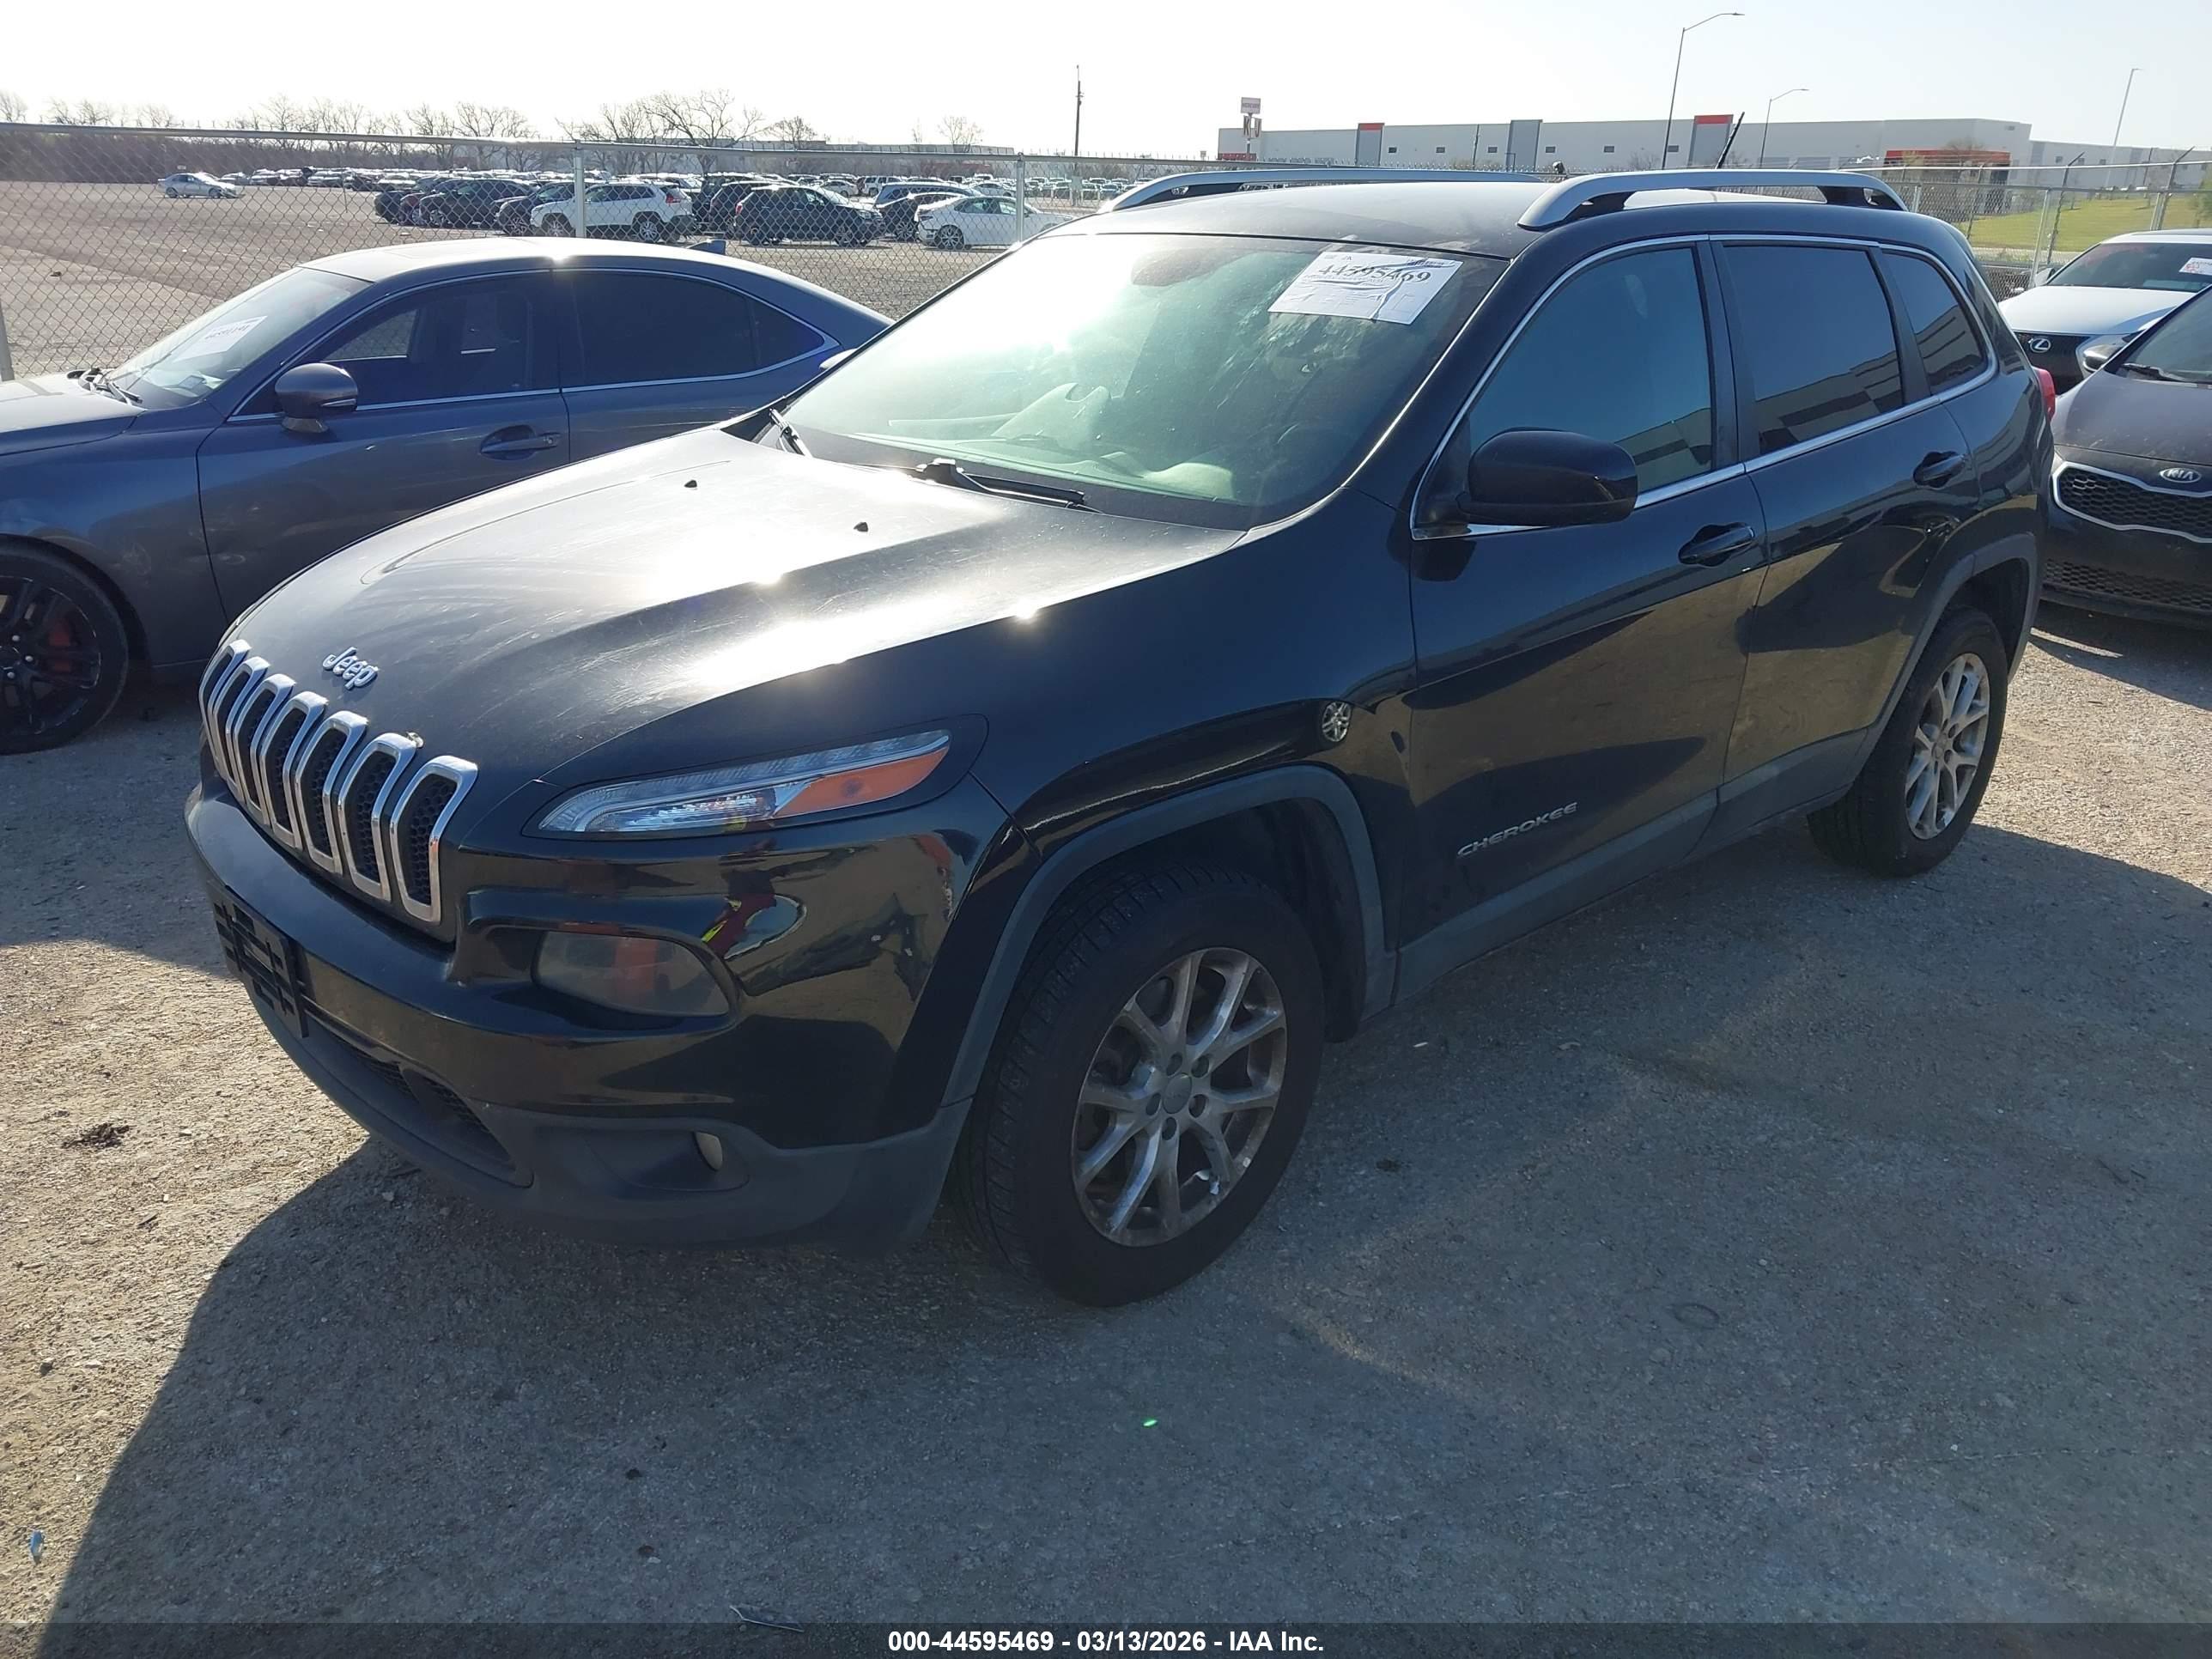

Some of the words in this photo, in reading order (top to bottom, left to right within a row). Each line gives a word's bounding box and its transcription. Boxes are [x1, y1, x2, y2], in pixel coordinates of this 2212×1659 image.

[2166, 469, 2194, 480] KIA
[323, 647, 379, 690] Jeep
[1457, 801, 1577, 857] CHEROKEE
